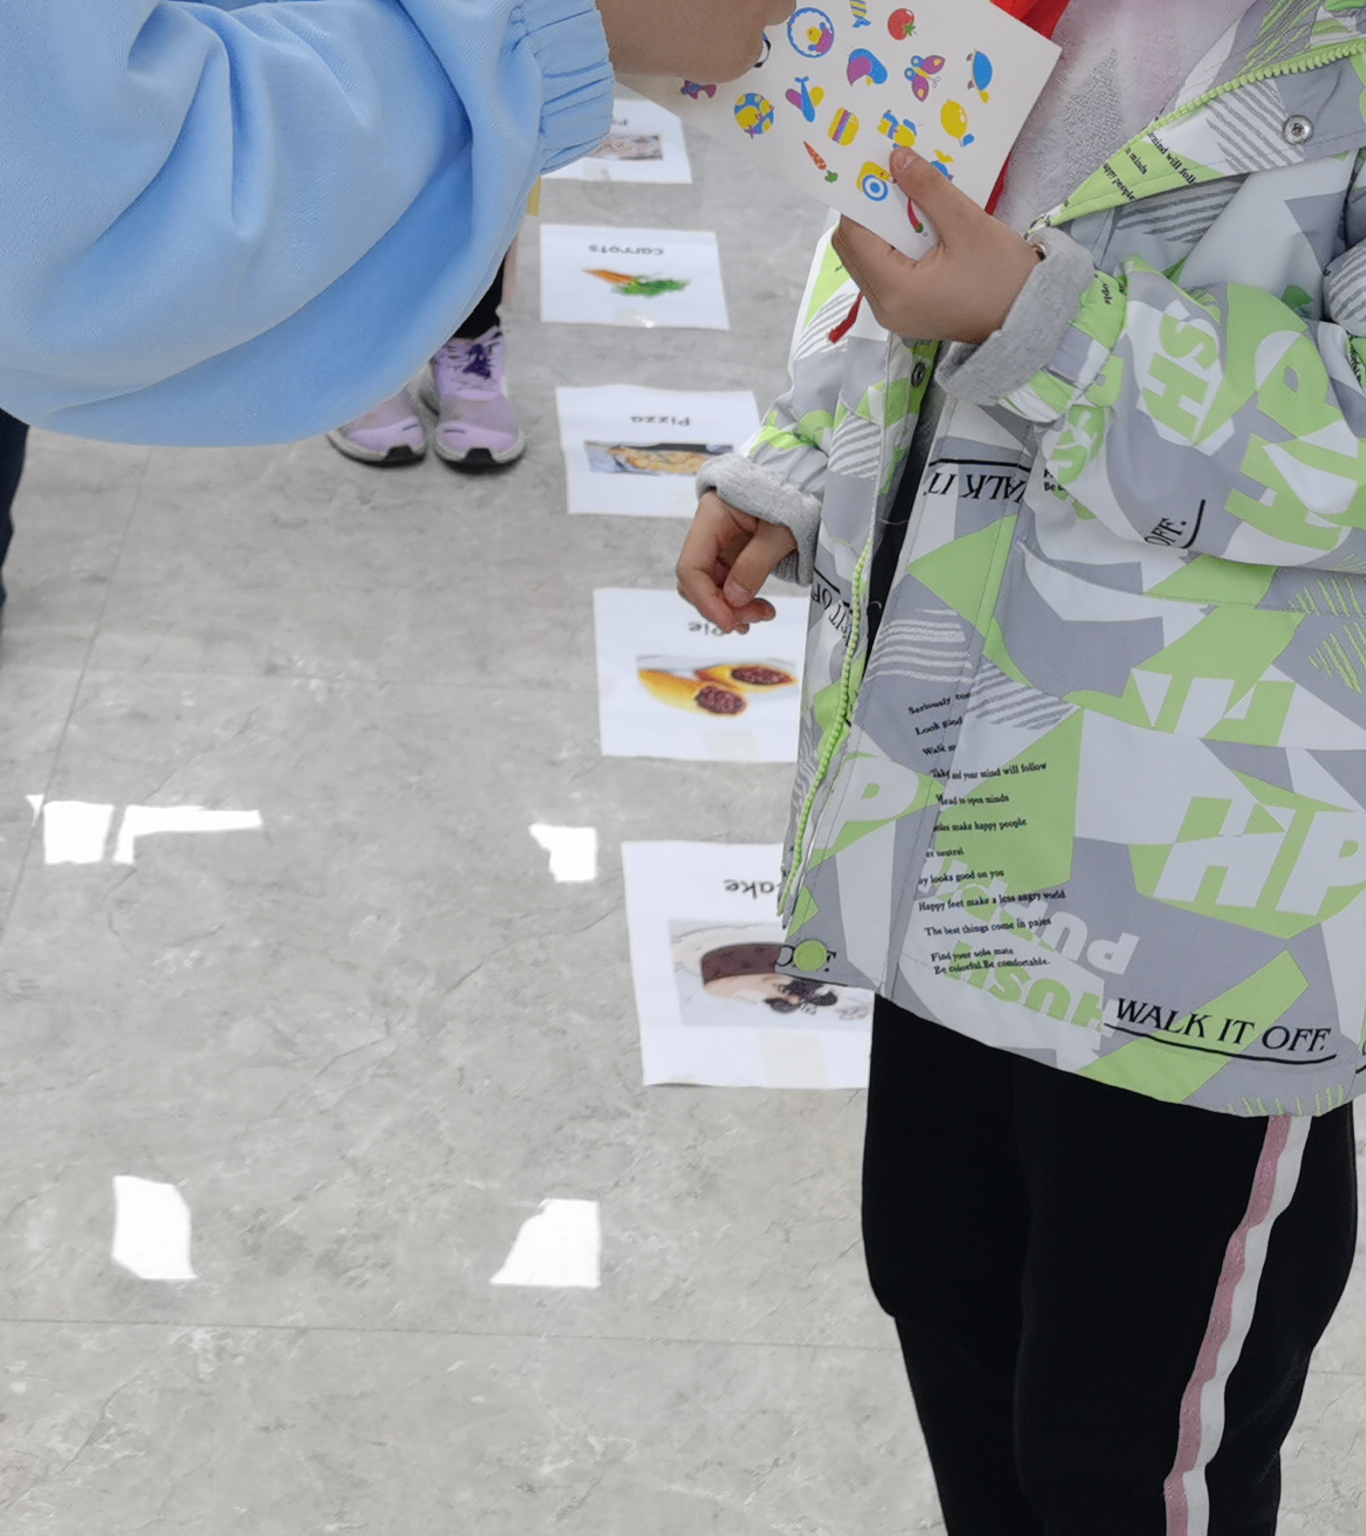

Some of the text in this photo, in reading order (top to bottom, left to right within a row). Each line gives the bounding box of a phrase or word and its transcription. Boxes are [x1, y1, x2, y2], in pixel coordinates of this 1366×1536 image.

[588, 244, 665, 257] carrots
[630, 415, 692, 427] Pizza
[723, 877, 780, 899] ake
[918, 900, 946, 913] Happy
[947, 897, 964, 910] feet
[966, 894, 990, 907] make
[923, 925, 942, 938] The
[961, 920, 990, 935] things
[1116, 997, 1332, 1053] WALK IT OFF.
